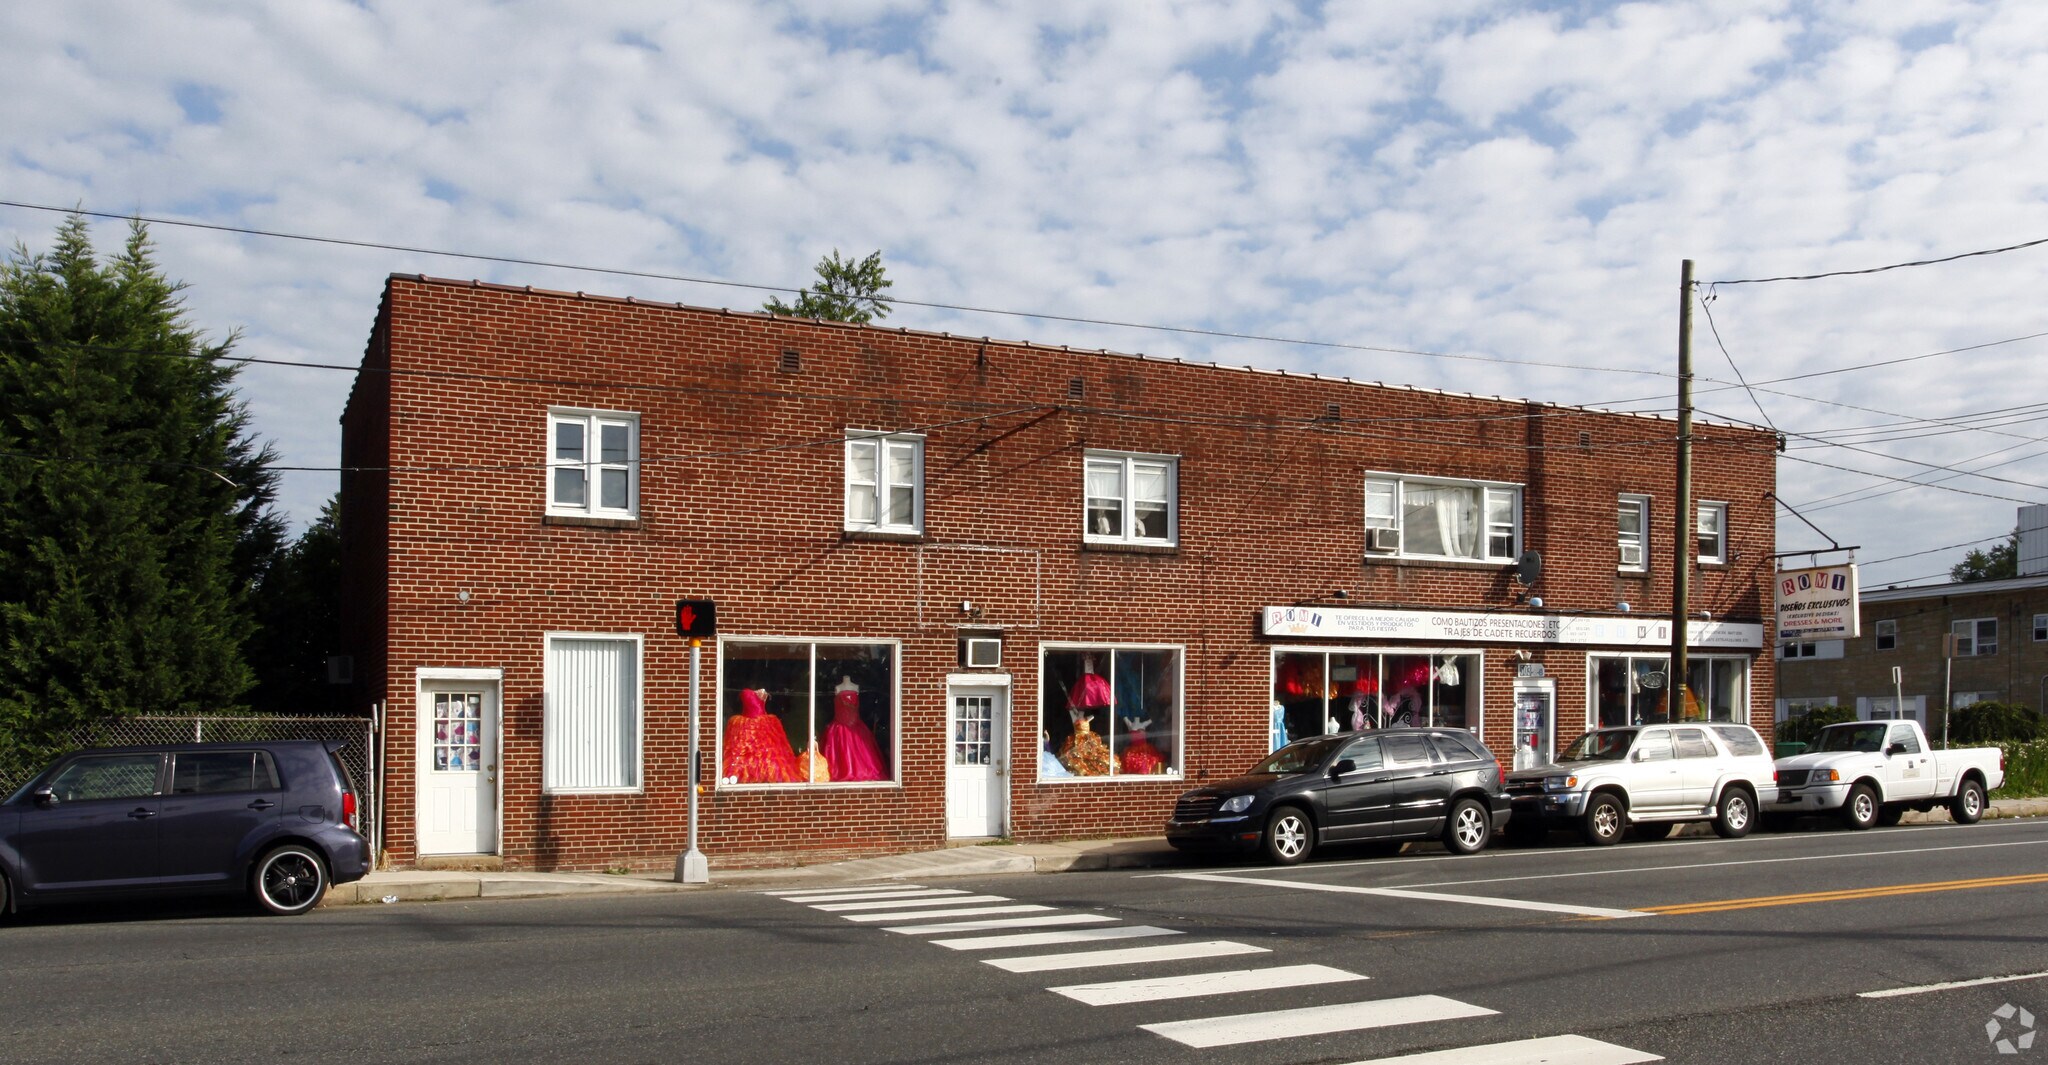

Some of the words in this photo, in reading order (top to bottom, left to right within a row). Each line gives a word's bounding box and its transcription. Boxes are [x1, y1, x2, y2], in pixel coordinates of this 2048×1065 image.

[1782, 573, 1846, 596] ROMI
[1780, 601, 1807, 612] DISEÑOS
[1807, 598, 1850, 610] EXCLUSIVOS
[1272, 609, 1322, 628] ROMI
[1431, 617, 1454, 626] COMO
[1455, 618, 1488, 627] BAUTIZOS
[1443, 627, 1471, 637] TRAJES
[1473, 629, 1483, 637] DE
[1484, 629, 1513, 638] CADETE
[1515, 630, 1557, 639] RECUERDOS
